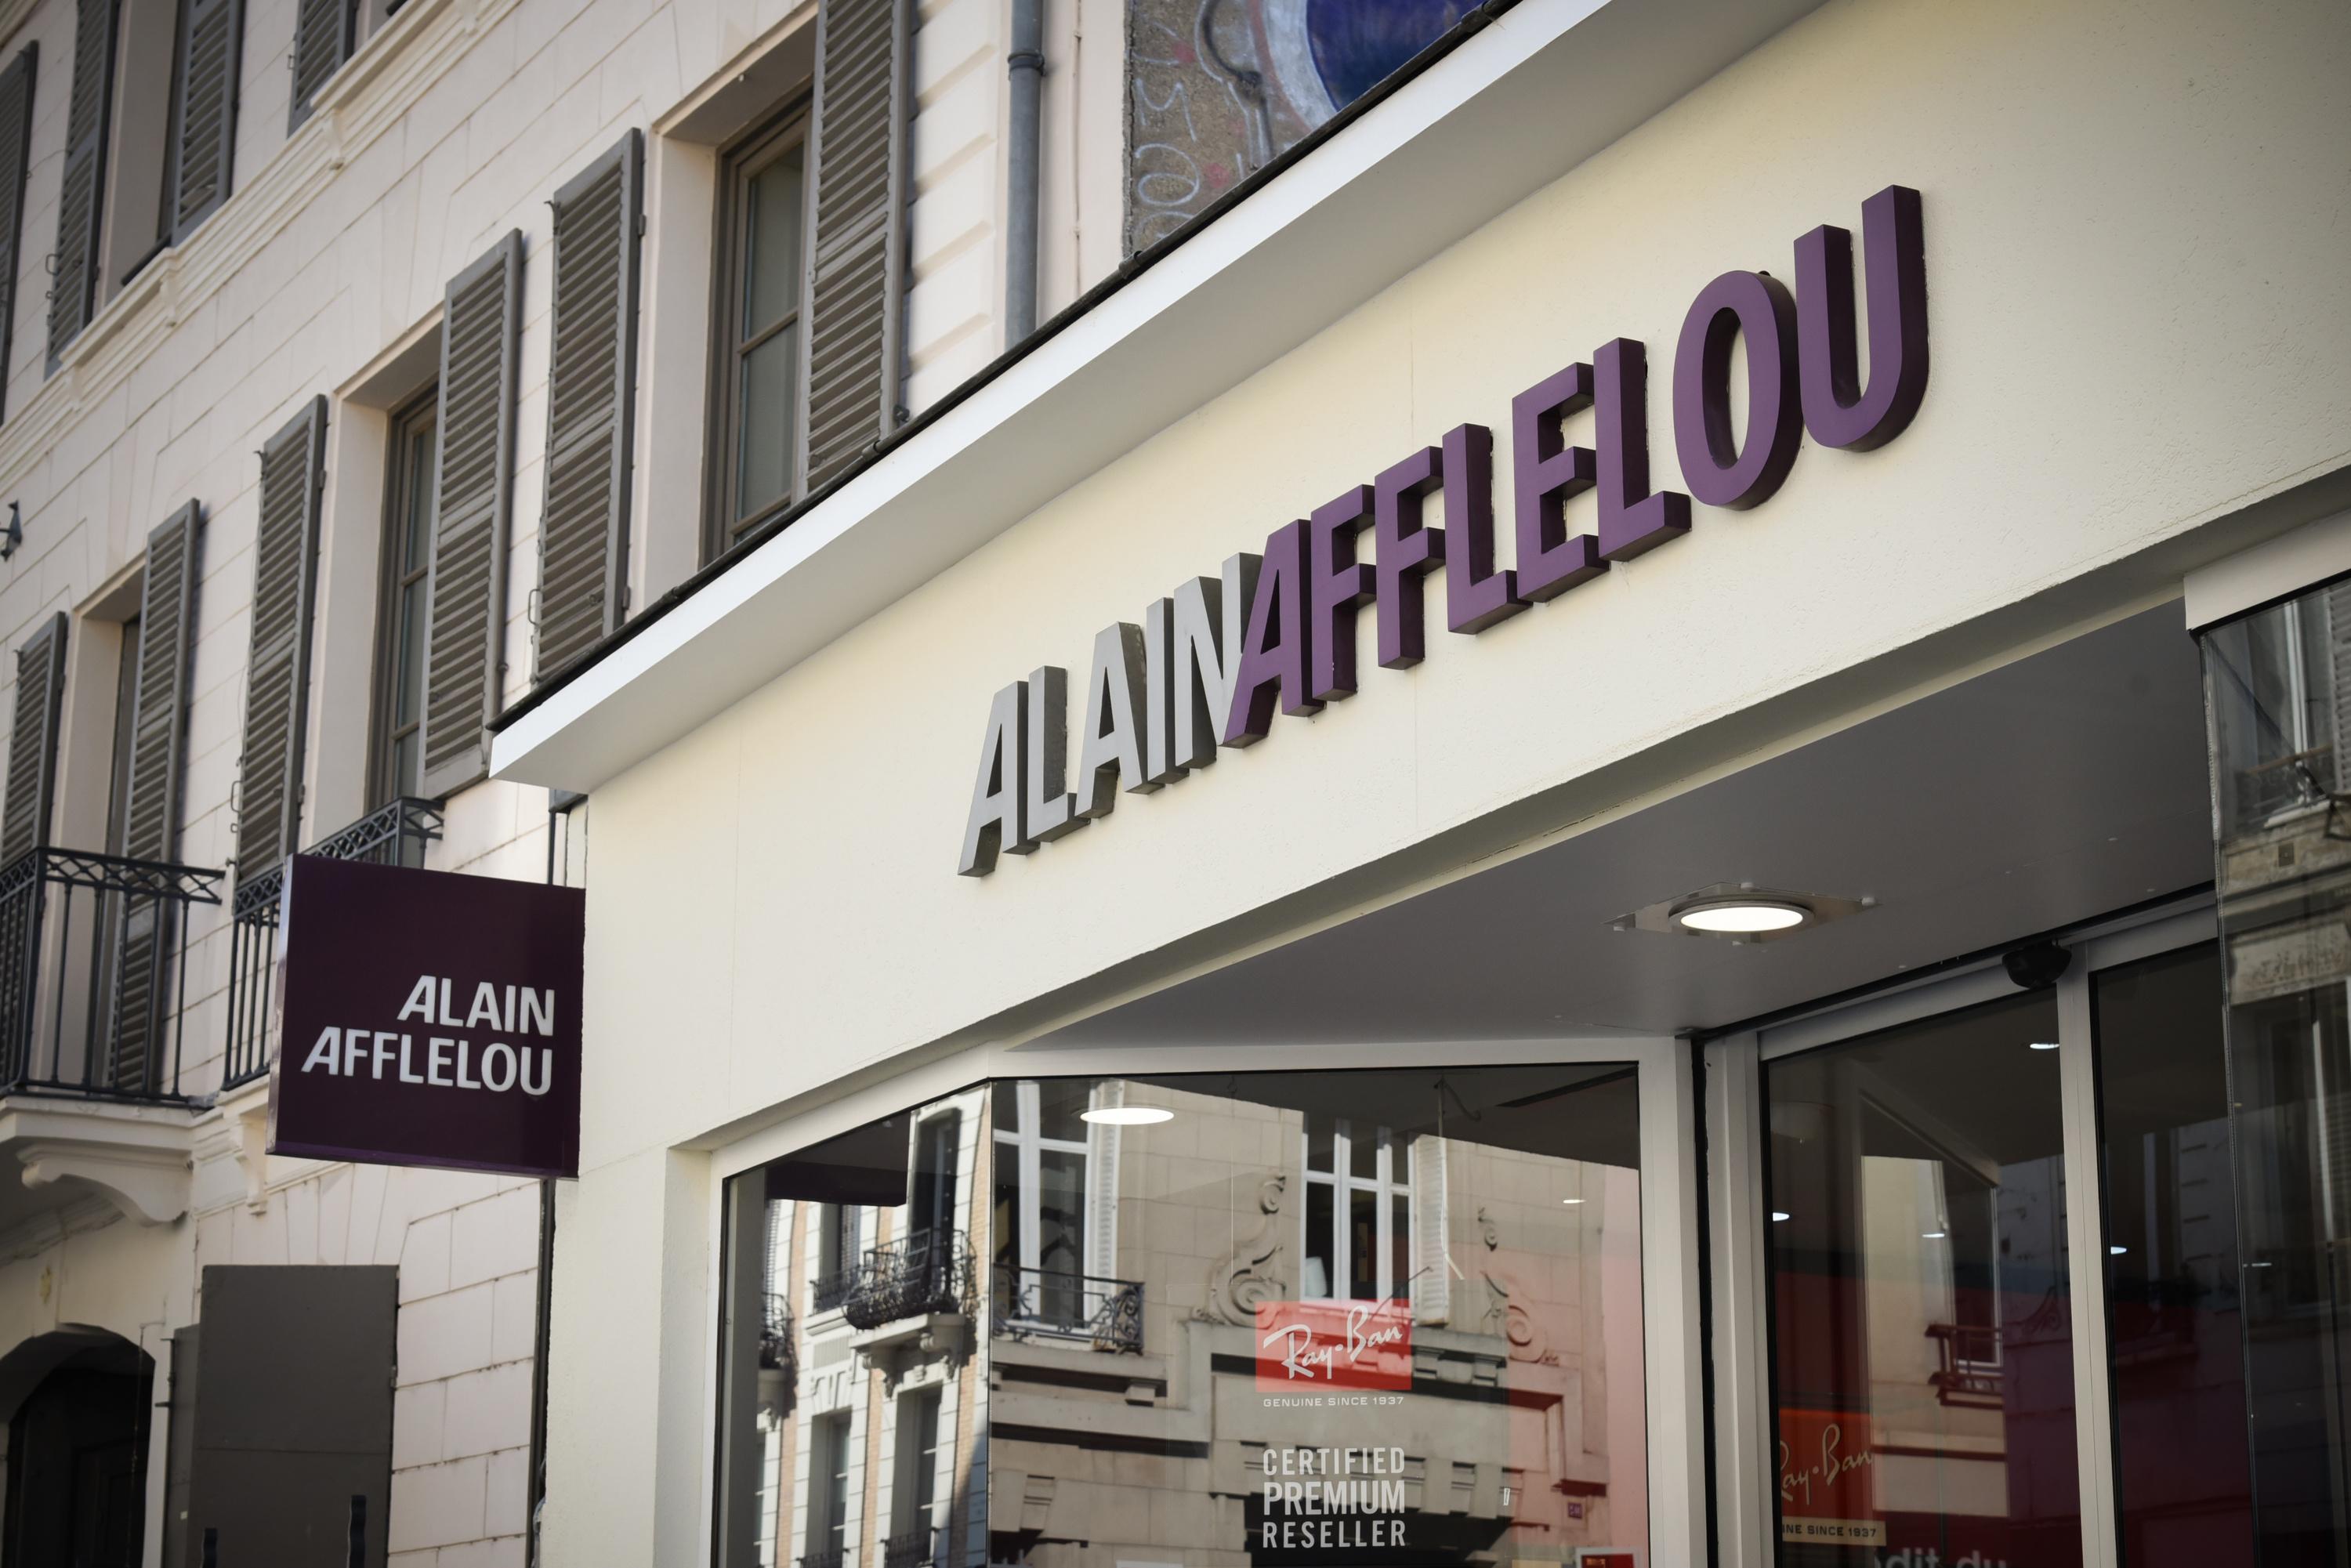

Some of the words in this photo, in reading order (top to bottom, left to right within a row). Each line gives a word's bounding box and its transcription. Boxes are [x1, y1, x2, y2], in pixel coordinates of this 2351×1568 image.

[958, 552, 1263, 877] ALAIN
[1221, 185, 1929, 748] AFFLELOU
[397, 975, 555, 1037] ALAIN
[301, 1026, 552, 1096] AFFLELOU
[1263, 1398, 1323, 1407] GENUINE
[1328, 1397, 1368, 1406] SINCE
[1373, 1396, 1404, 1405] 1937
[1262, 1447, 1405, 1476] CERTIFIED
[1263, 1479, 1405, 1515] PREMIUM
[1262, 1520, 1405, 1548] RESELLER
[1807, 1526, 1844, 1536] SINCE
[1848, 1528, 1876, 1537] 1937
